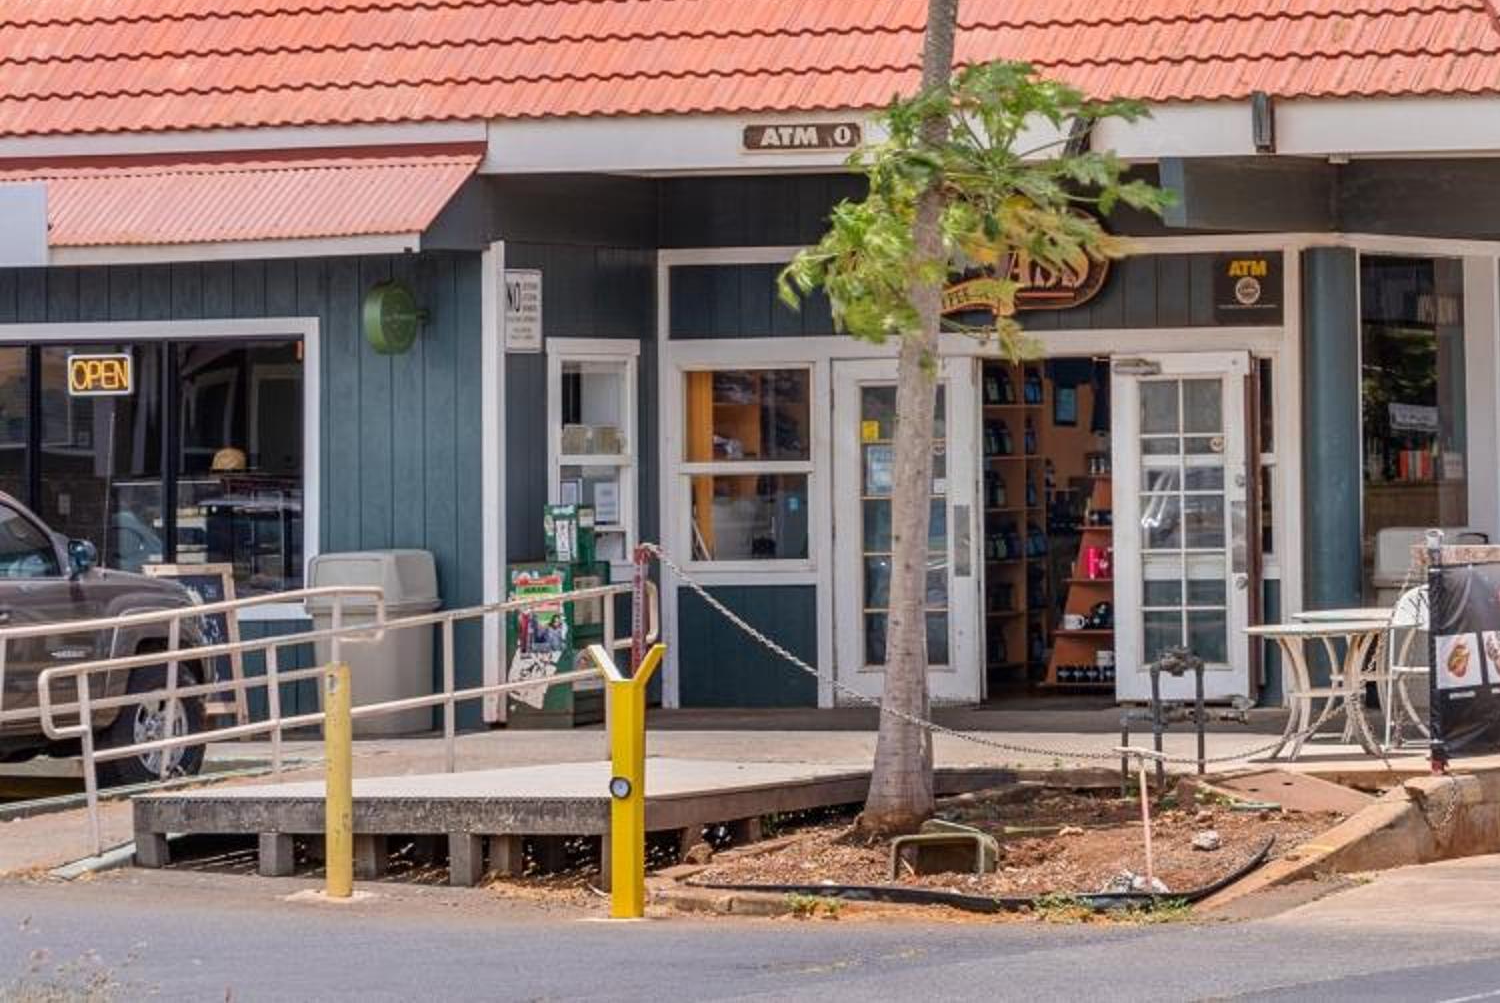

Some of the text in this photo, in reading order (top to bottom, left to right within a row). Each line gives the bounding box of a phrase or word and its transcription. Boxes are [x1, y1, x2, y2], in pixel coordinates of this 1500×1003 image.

[760, 125, 819, 147] ATM
[1229, 260, 1268, 277] ATM
[505, 281, 521, 313] NO
[72, 360, 128, 390] OPEN
